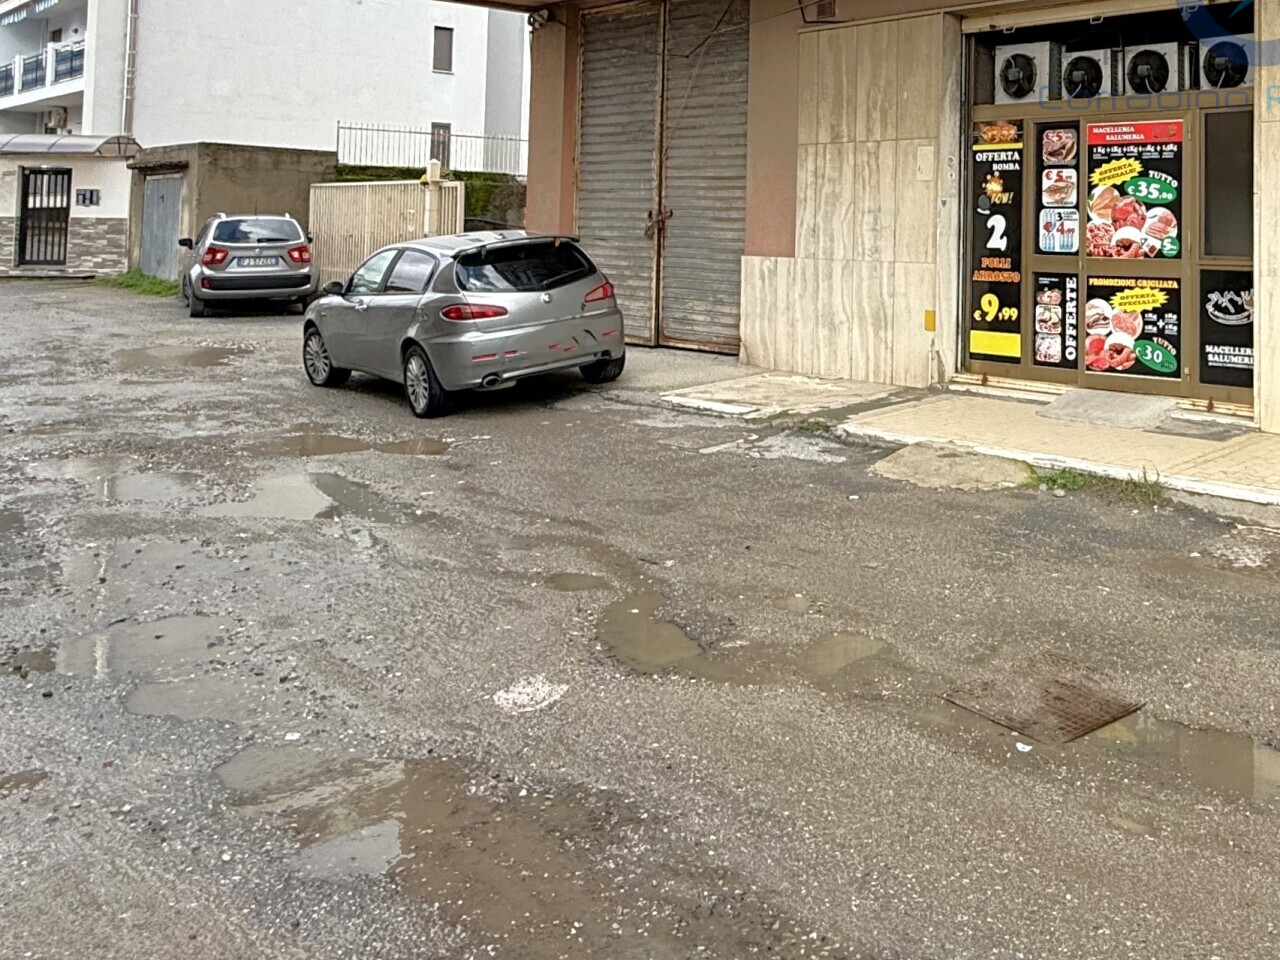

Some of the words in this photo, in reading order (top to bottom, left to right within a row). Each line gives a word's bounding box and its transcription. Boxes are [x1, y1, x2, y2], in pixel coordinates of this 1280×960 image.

[1092, 126, 1135, 134] MACELLERIA
[1105, 133, 1145, 141] SALUMERIA
[975, 151, 1021, 162] OFFERTA
[992, 163, 1021, 171] BOMBA
[1098, 162, 1133, 176] OFFERTA
[1097, 167, 1137, 183] SPECIALE!
[1148, 170, 1178, 187] TUTTO
[986, 214, 1008, 252] 2
[980, 258, 1012, 269] POLLI
[972, 271, 1021, 283] ARROSTO
[1088, 278, 1136, 287] PROMOZIONE
[1136, 279, 1179, 289] GRIGLIATA
[1119, 293, 1157, 301] OFFERTA
[1118, 299, 1160, 307] SPECIALE!
[1065, 277, 1078, 361] OFFERTE
[1152, 337, 1177, 356] TUTTO
[1205, 345, 1253, 356] MACELLER
